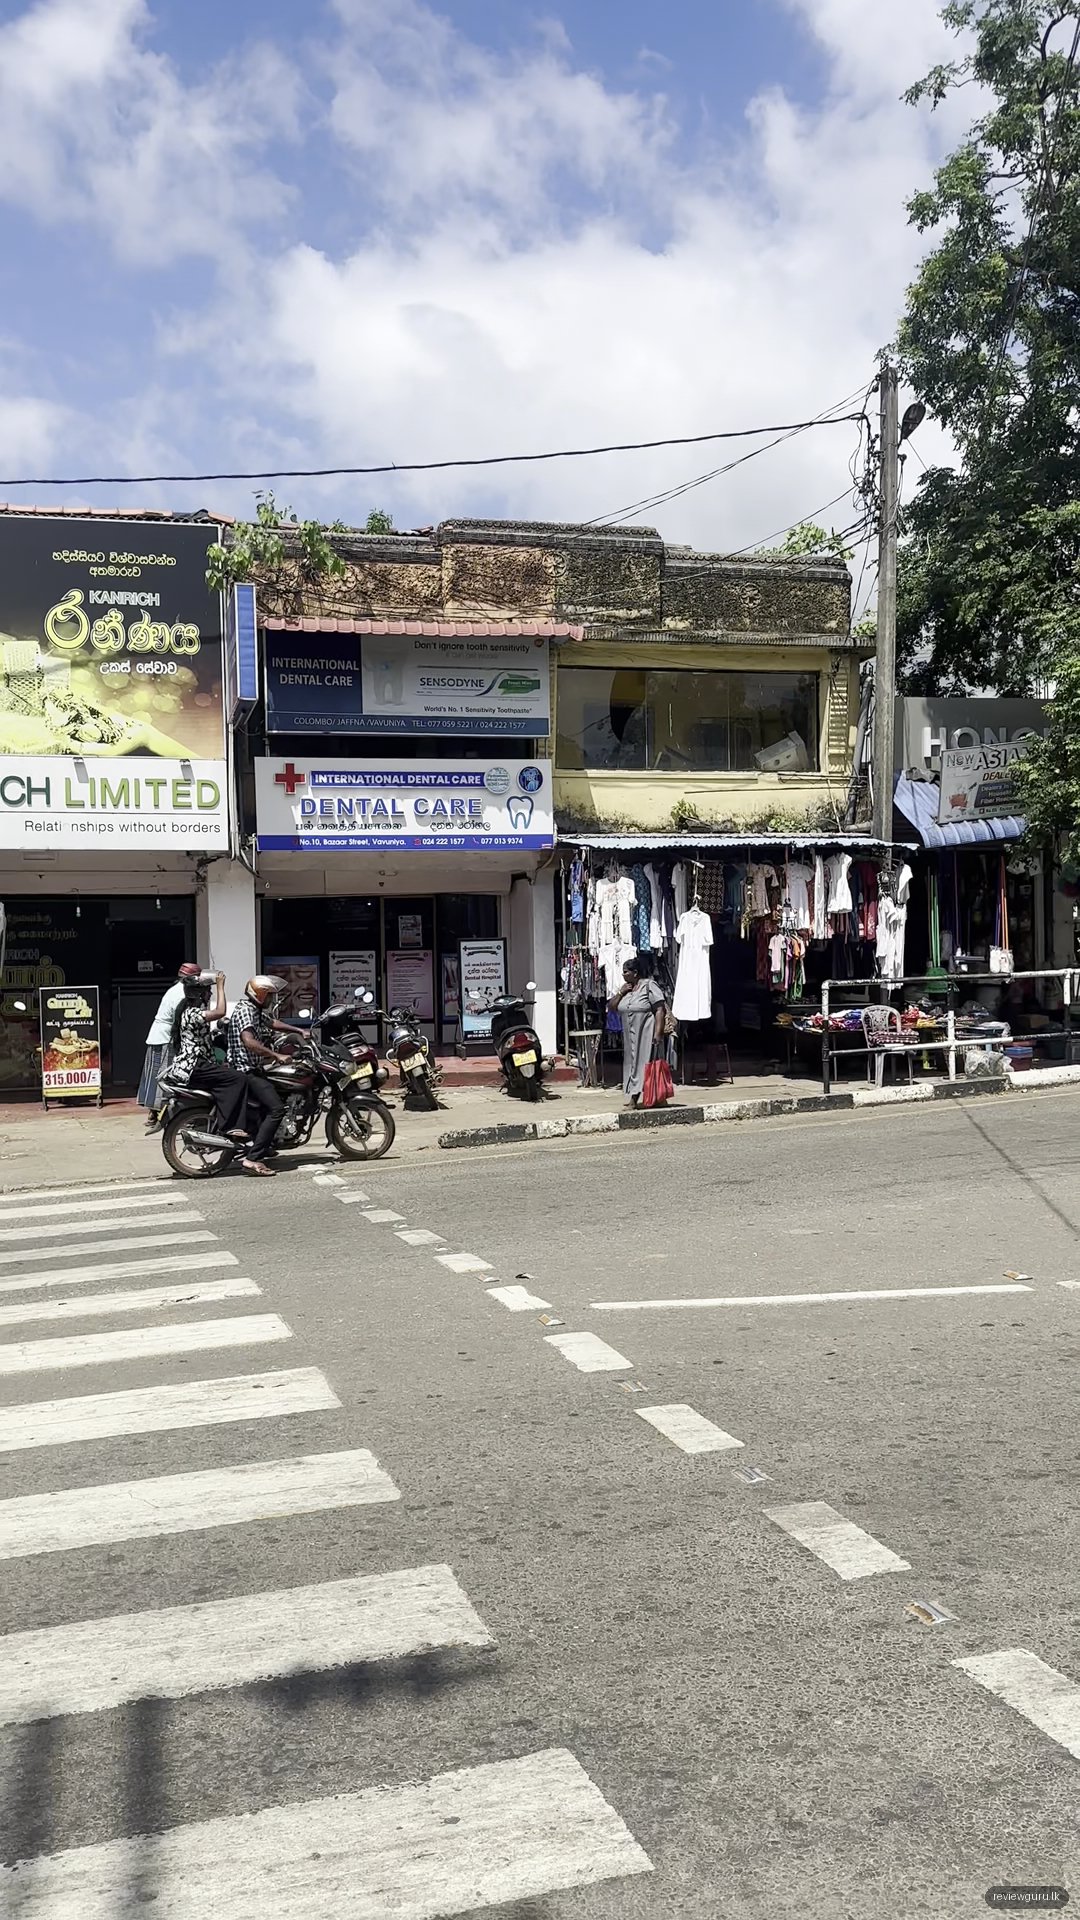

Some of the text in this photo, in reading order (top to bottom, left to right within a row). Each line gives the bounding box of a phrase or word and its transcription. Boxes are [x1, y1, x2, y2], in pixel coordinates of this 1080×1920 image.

[89, 590, 161, 606] KANRICH
[414, 640, 530, 654] Don't ignore tooth sensitivity
[271, 656, 360, 671] INTERNATIONAL
[279, 673, 353, 687] DENTAL CARE
[419, 677, 485, 689] SENSODYNE
[423, 705, 447, 713] World's
[447, 705, 459, 713] No.
[465, 706, 496, 715] Sensitivity
[338, 718, 365, 726] JAFFNA
[412, 720, 427, 728] TEL:
[427, 720, 441, 728] 077
[442, 720, 456, 728] 059
[457, 720, 474, 729] 5221
[480, 721, 494, 729] 024
[509, 722, 526, 730] 1577
[946, 754, 975, 767] New
[315, 774, 405, 784] INTERNATIONAL
[407, 775, 450, 784] DENTAL
[451, 775, 481, 784] CARE
[65, 777, 221, 809] LIMITED
[300, 798, 481, 816] DENTAL CARE
[119, 821, 166, 833] without
[172, 821, 221, 833] borders
[348, 839, 370, 847] Street,
[372, 839, 406, 847] Vavuniya.
[422, 837, 435, 845] 024
[436, 837, 448, 845] 222
[450, 837, 465, 845] 1577
[480, 837, 493, 845] 077
[494, 837, 507, 845] 013
[508, 837, 523, 845] 9374
